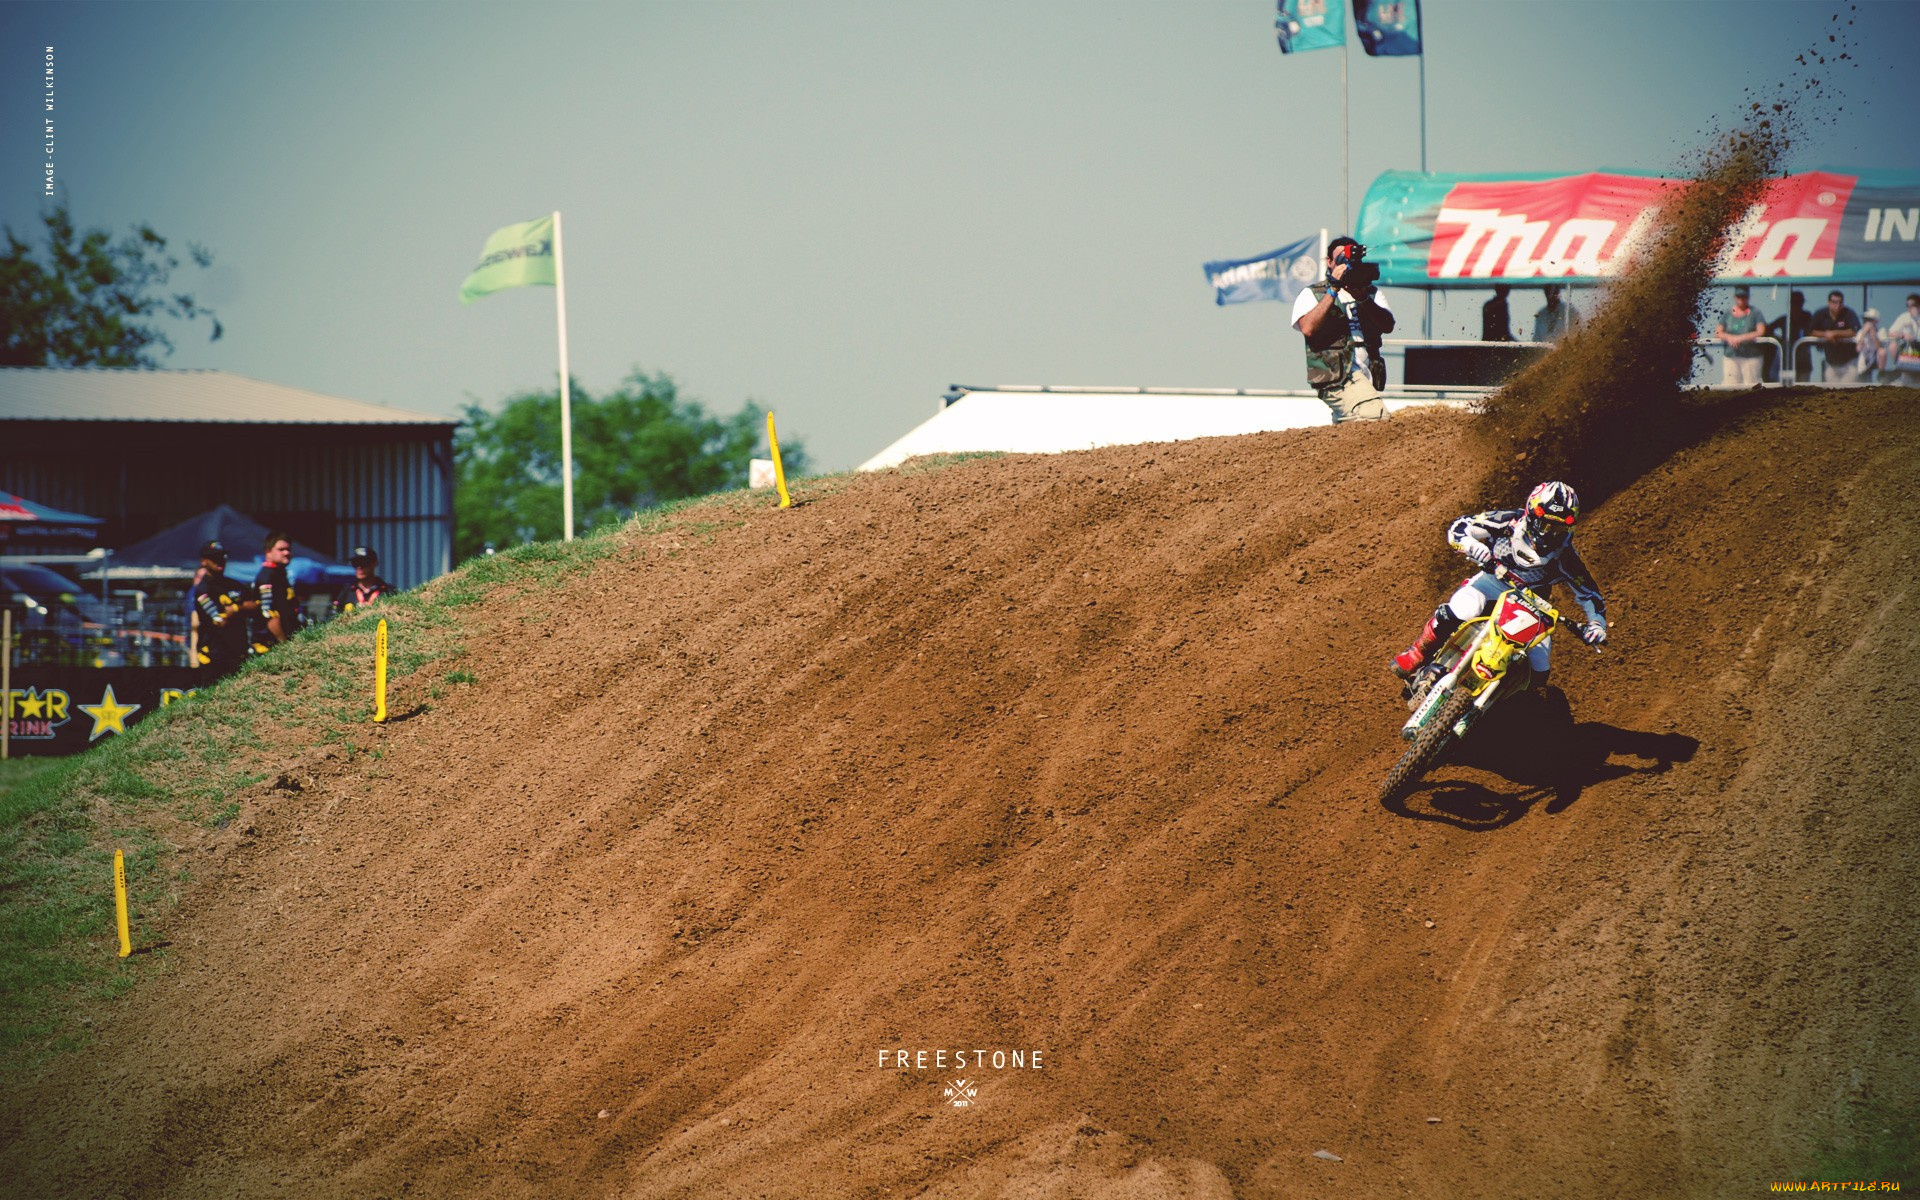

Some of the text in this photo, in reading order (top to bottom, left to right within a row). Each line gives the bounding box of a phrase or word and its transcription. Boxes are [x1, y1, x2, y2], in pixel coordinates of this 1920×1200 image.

[1864, 208, 1920, 242] IN
[1438, 205, 1834, 277] Mata
[1500, 608, 1540, 636] 1
[0, 720, 53, 735] RINK
